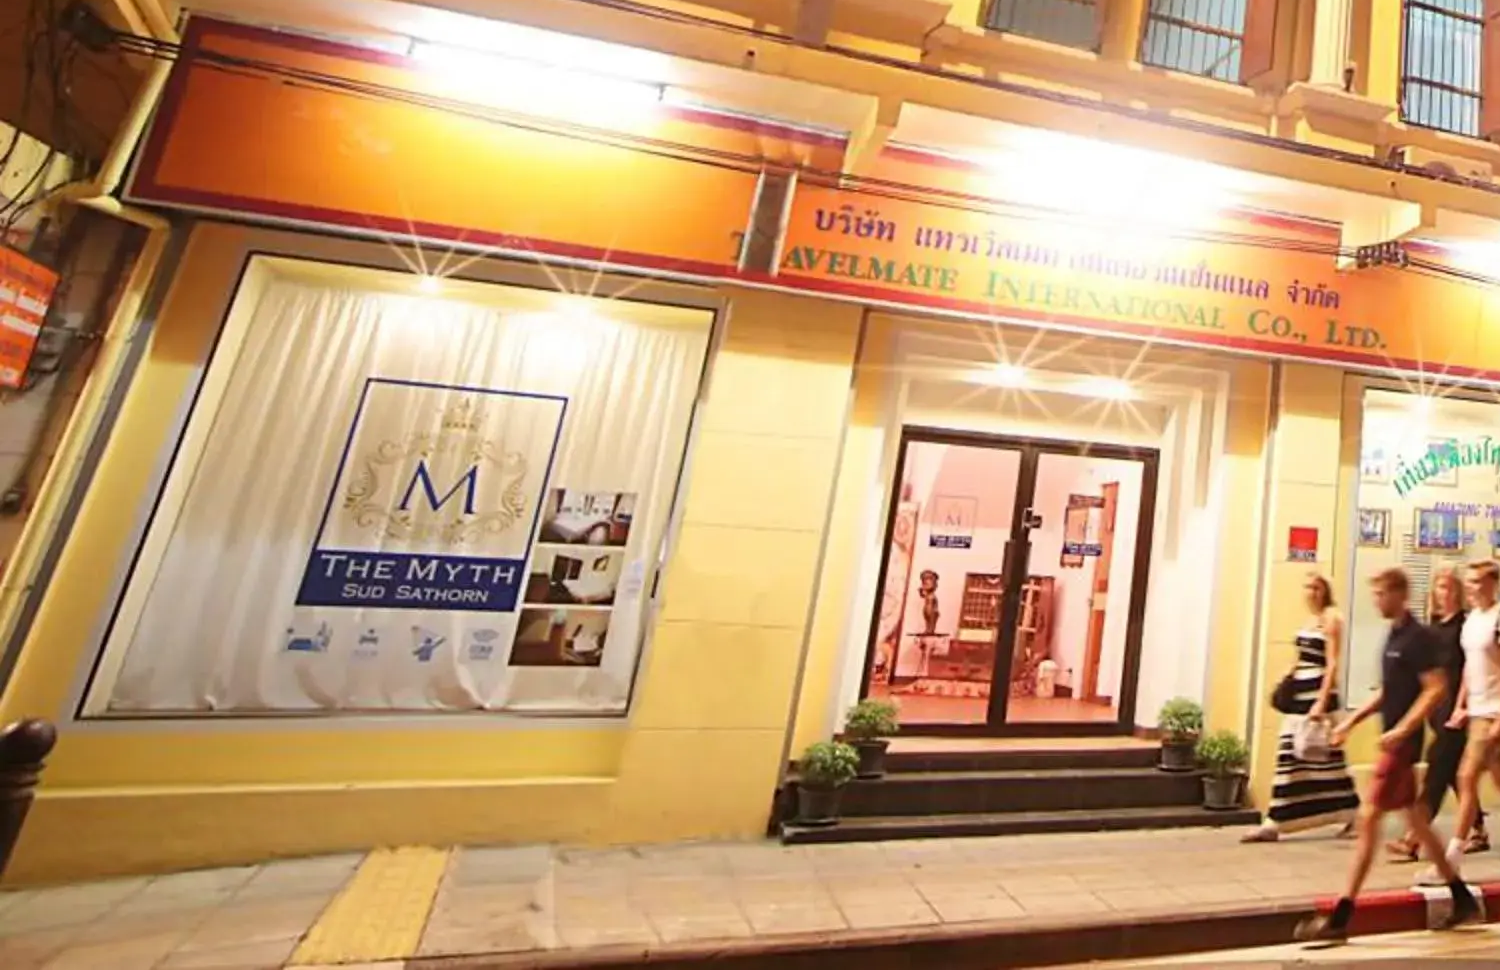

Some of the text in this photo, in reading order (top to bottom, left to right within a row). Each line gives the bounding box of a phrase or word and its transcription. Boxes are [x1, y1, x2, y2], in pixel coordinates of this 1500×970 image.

[814, 205, 896, 243] บริษัท
[1287, 281, 1341, 311] จำกัด
[730, 230, 1388, 350] TAVELMATE INTERNATIONAL CO., LTD.
[399, 459, 478, 515] M
[321, 554, 515, 585] THE MYTH
[342, 583, 490, 604] SUD SATHORN
